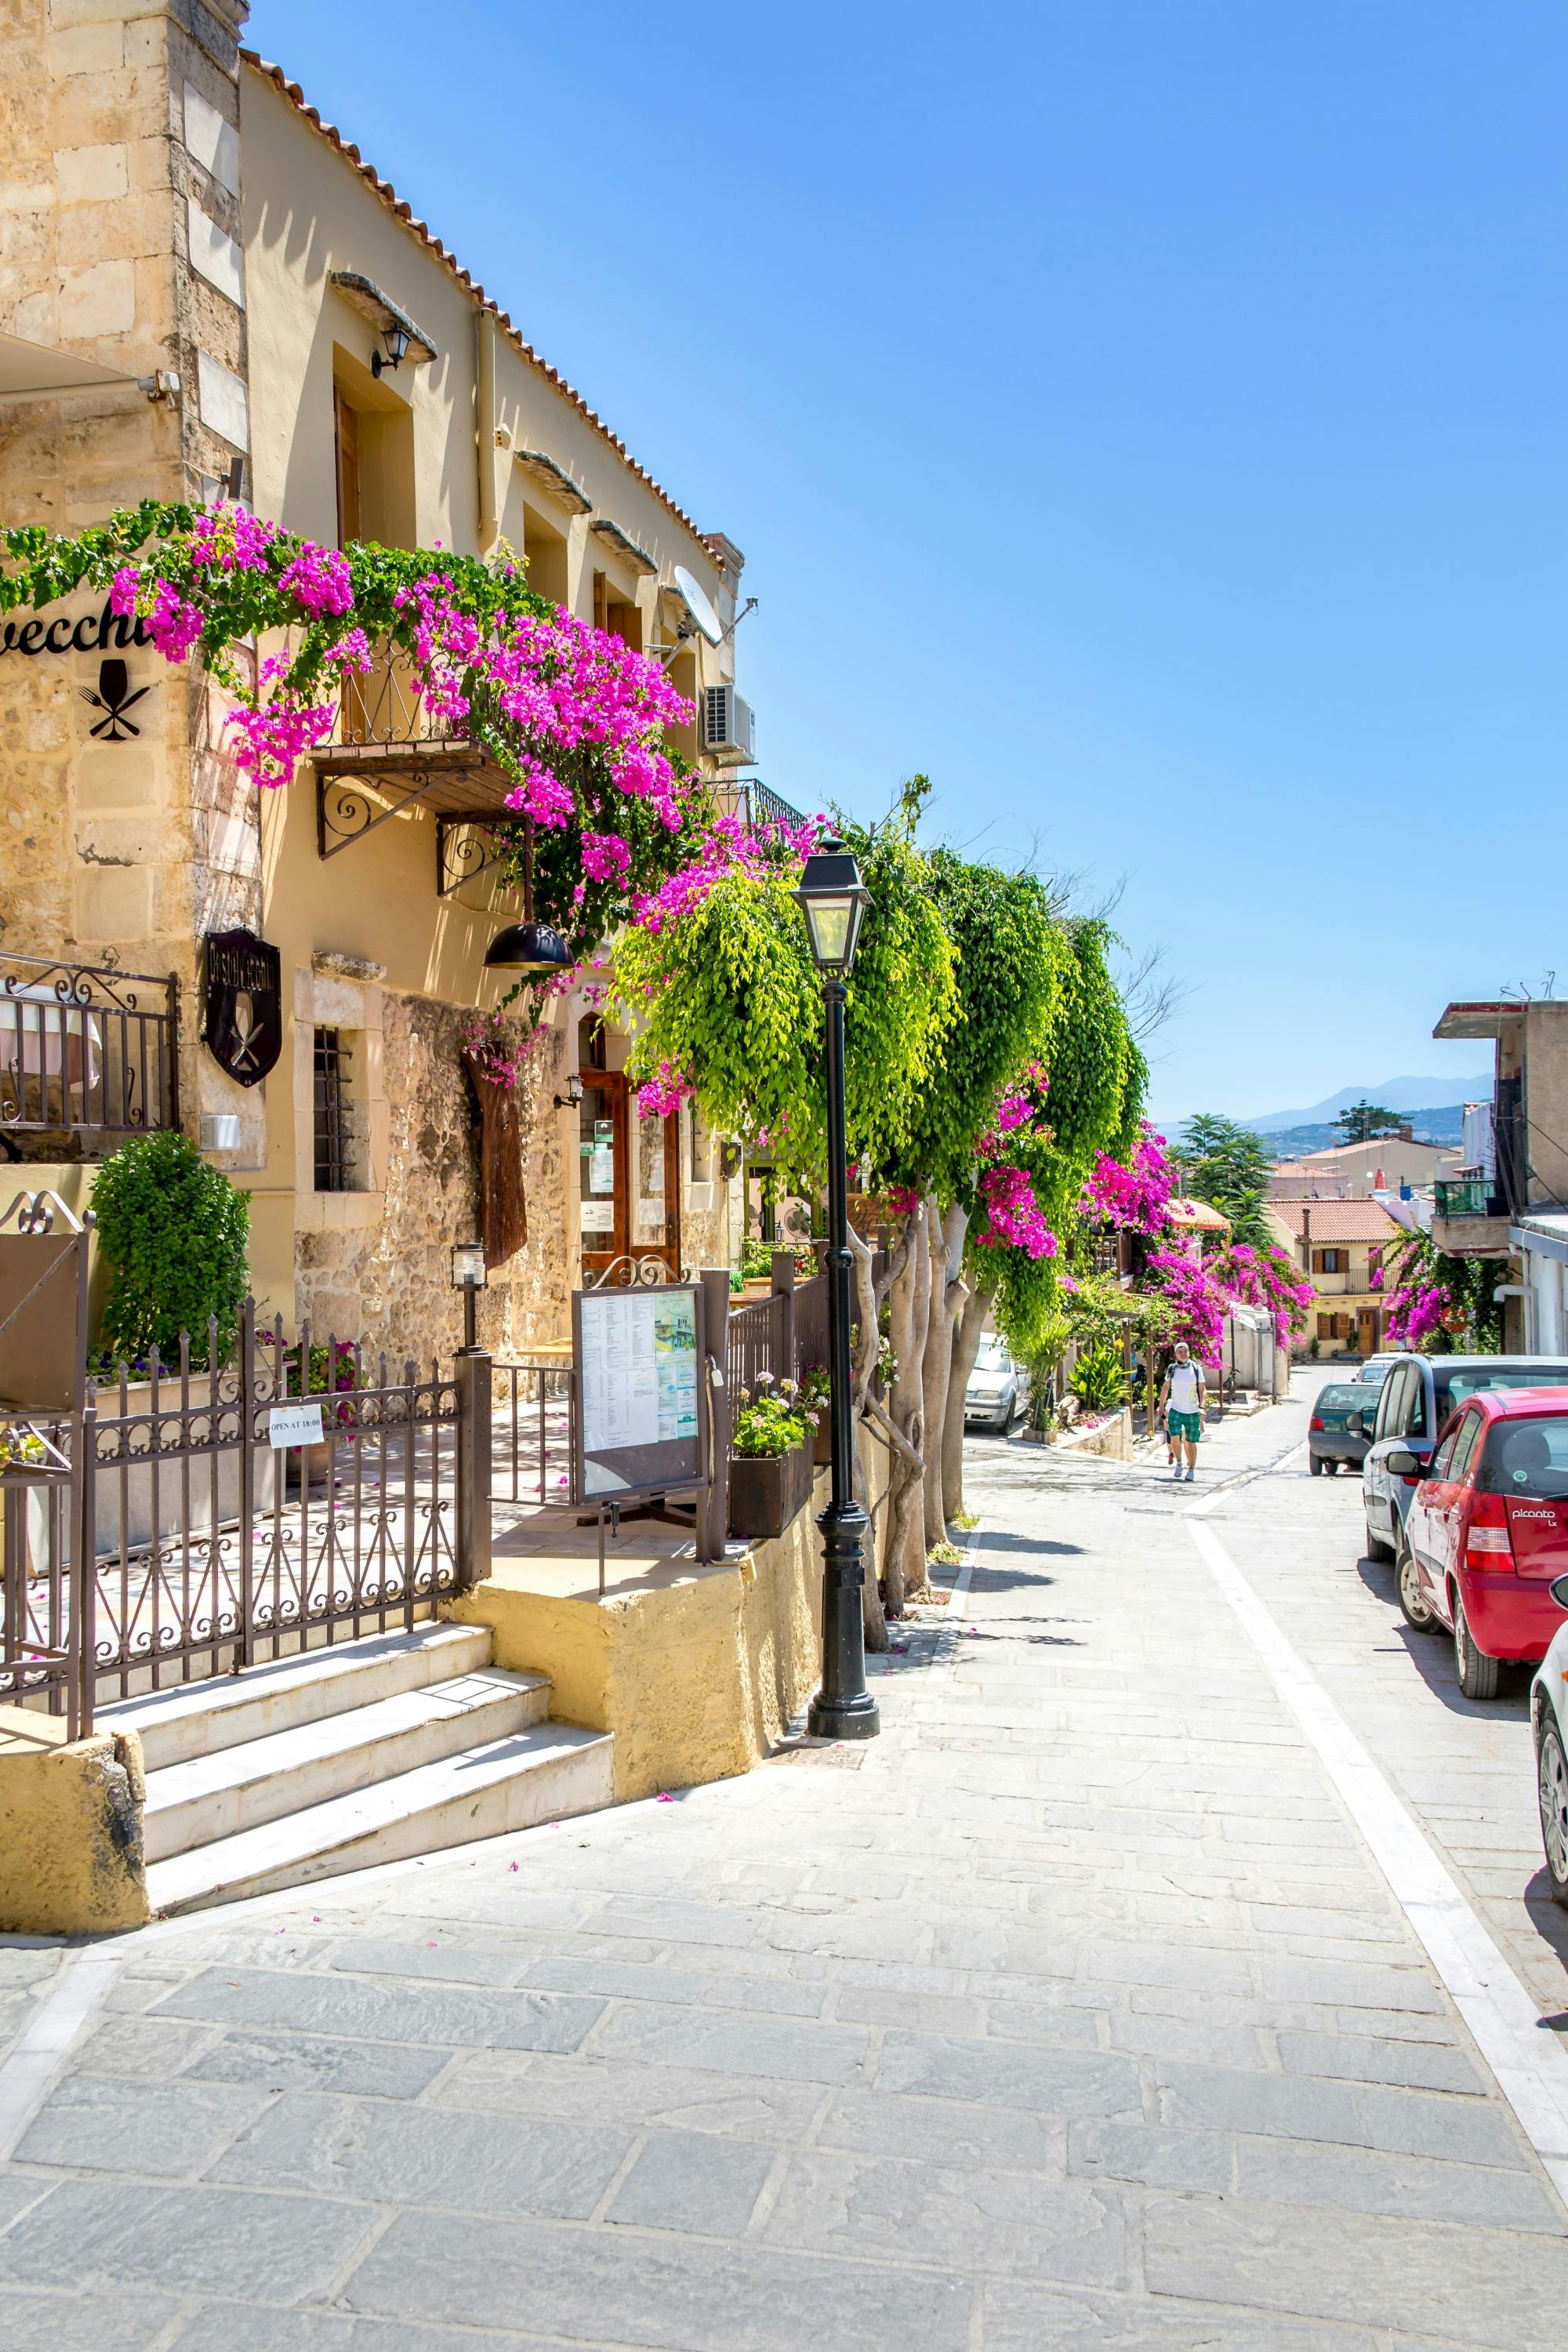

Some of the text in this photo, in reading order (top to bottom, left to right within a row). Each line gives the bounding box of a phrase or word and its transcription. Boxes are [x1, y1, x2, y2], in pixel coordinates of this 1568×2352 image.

[271, 1422, 289, 1431] OPEN
[303, 1419, 320, 1428] 18:00
[1512, 1508, 1555, 1519] picanto
